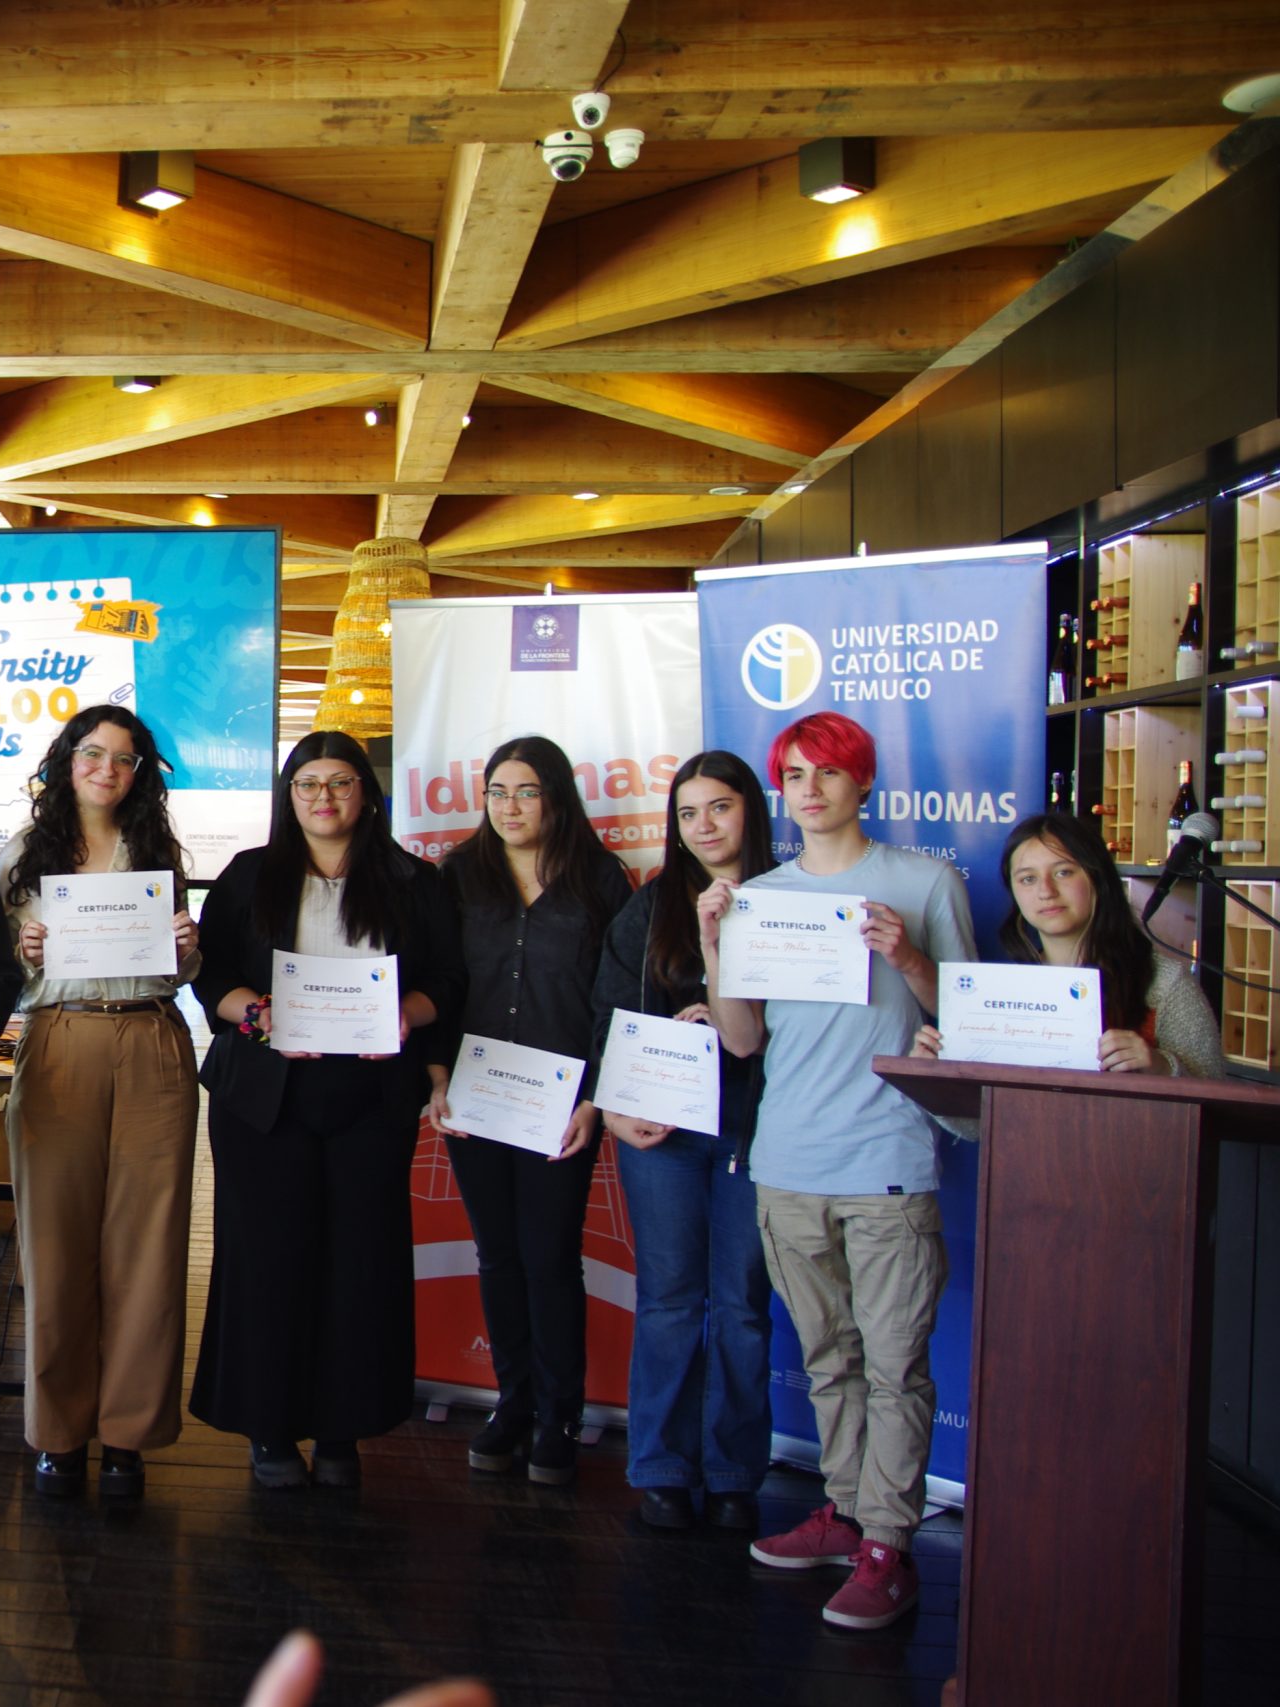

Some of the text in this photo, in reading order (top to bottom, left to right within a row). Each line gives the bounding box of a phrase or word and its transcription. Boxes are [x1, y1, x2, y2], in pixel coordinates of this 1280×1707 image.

[831, 620, 998, 648] UNIVERSIDAD
[831, 649, 983, 675] CATÓLICA DE
[830, 678, 931, 701] TEMUCO
[879, 791, 1017, 823] IDIOMAS
[78, 904, 138, 913] CERTIFICADO
[760, 921, 827, 932] CERTIFICADO
[304, 984, 362, 994] CERTIFICADO
[984, 1000, 1058, 1012] CERTIFICADO
[642, 1046, 698, 1062] CERTIFICADO
[488, 1068, 544, 1088] CERTIFICADO
